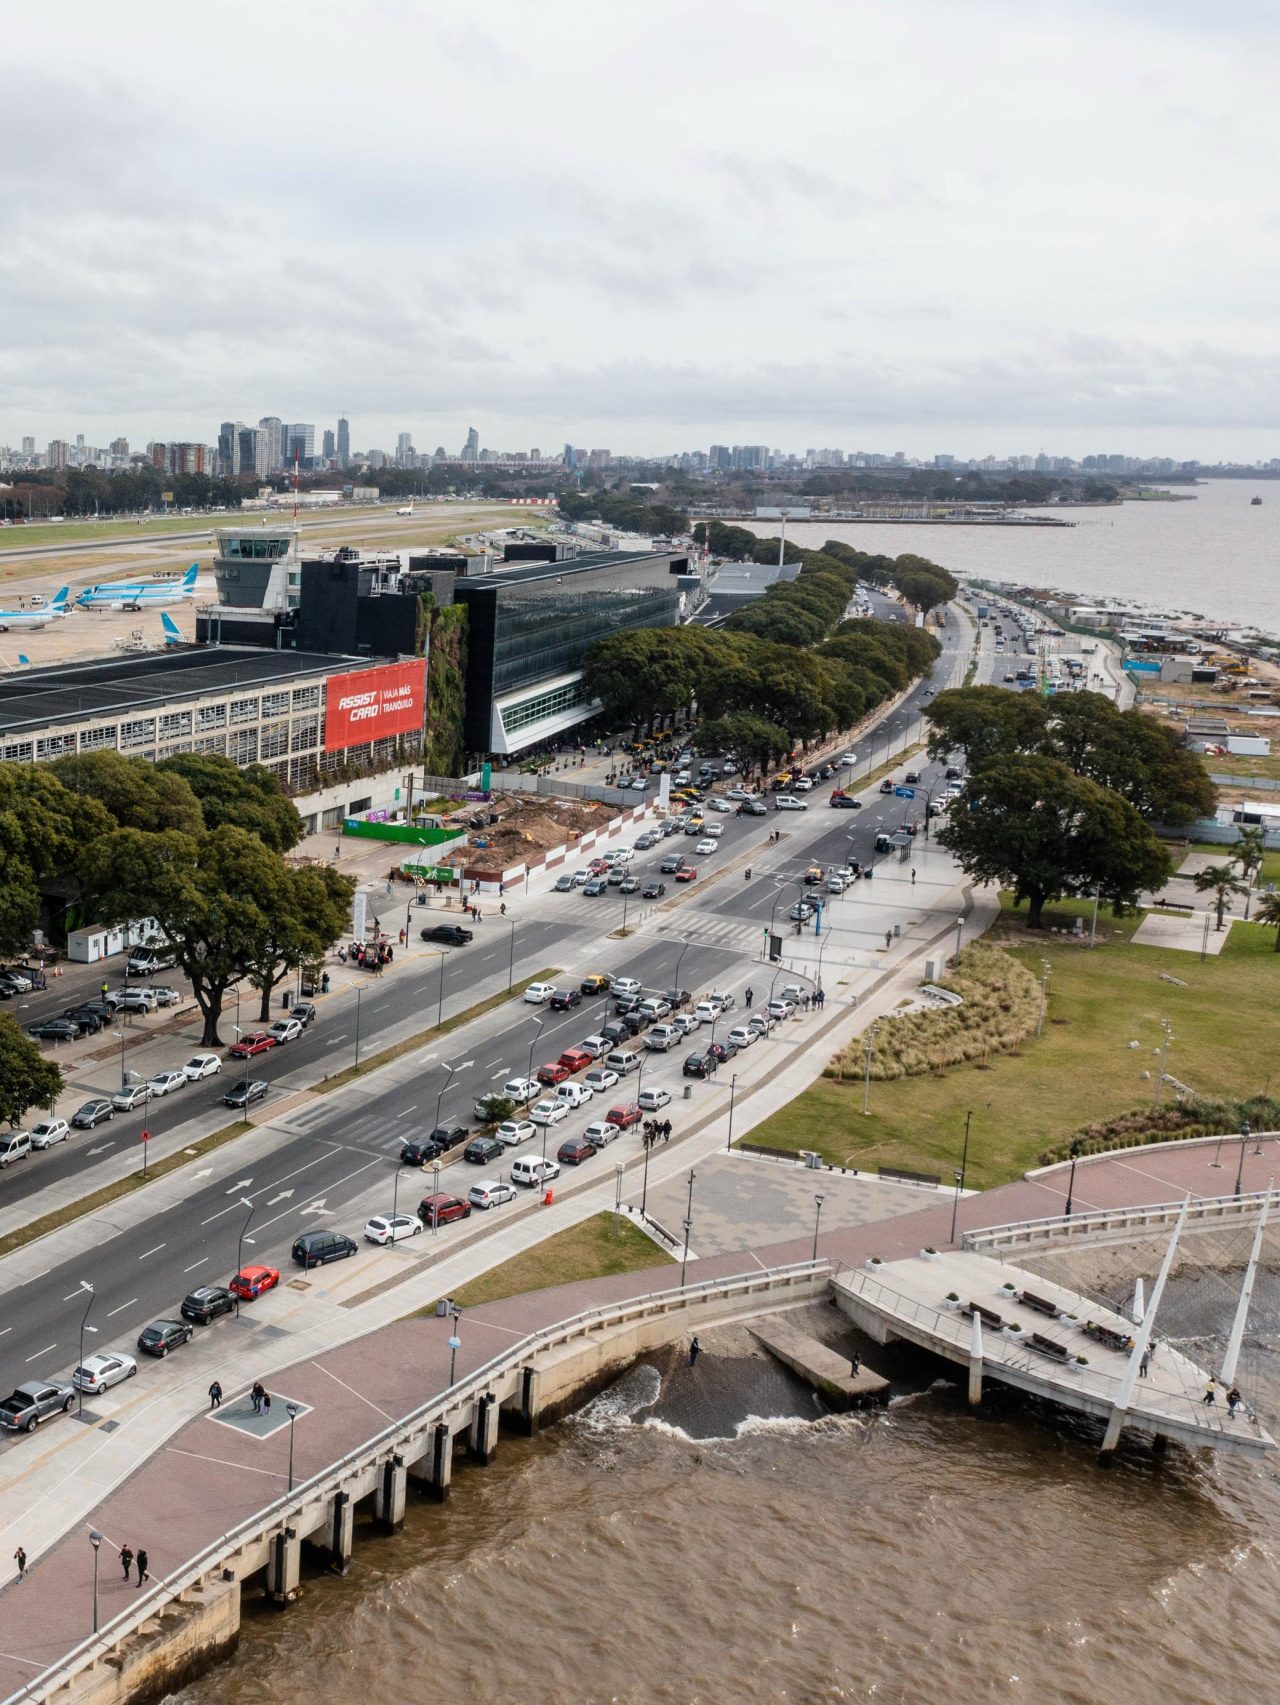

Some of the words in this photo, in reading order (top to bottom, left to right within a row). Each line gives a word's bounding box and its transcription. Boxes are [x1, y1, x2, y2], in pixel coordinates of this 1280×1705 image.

[383, 688, 398, 699] VIAJA
[399, 684, 410, 695] MÁS
[339, 691, 376, 710] ASSIST
[383, 698, 412, 712] TRANQUILO
[350, 705, 378, 721] CARD
